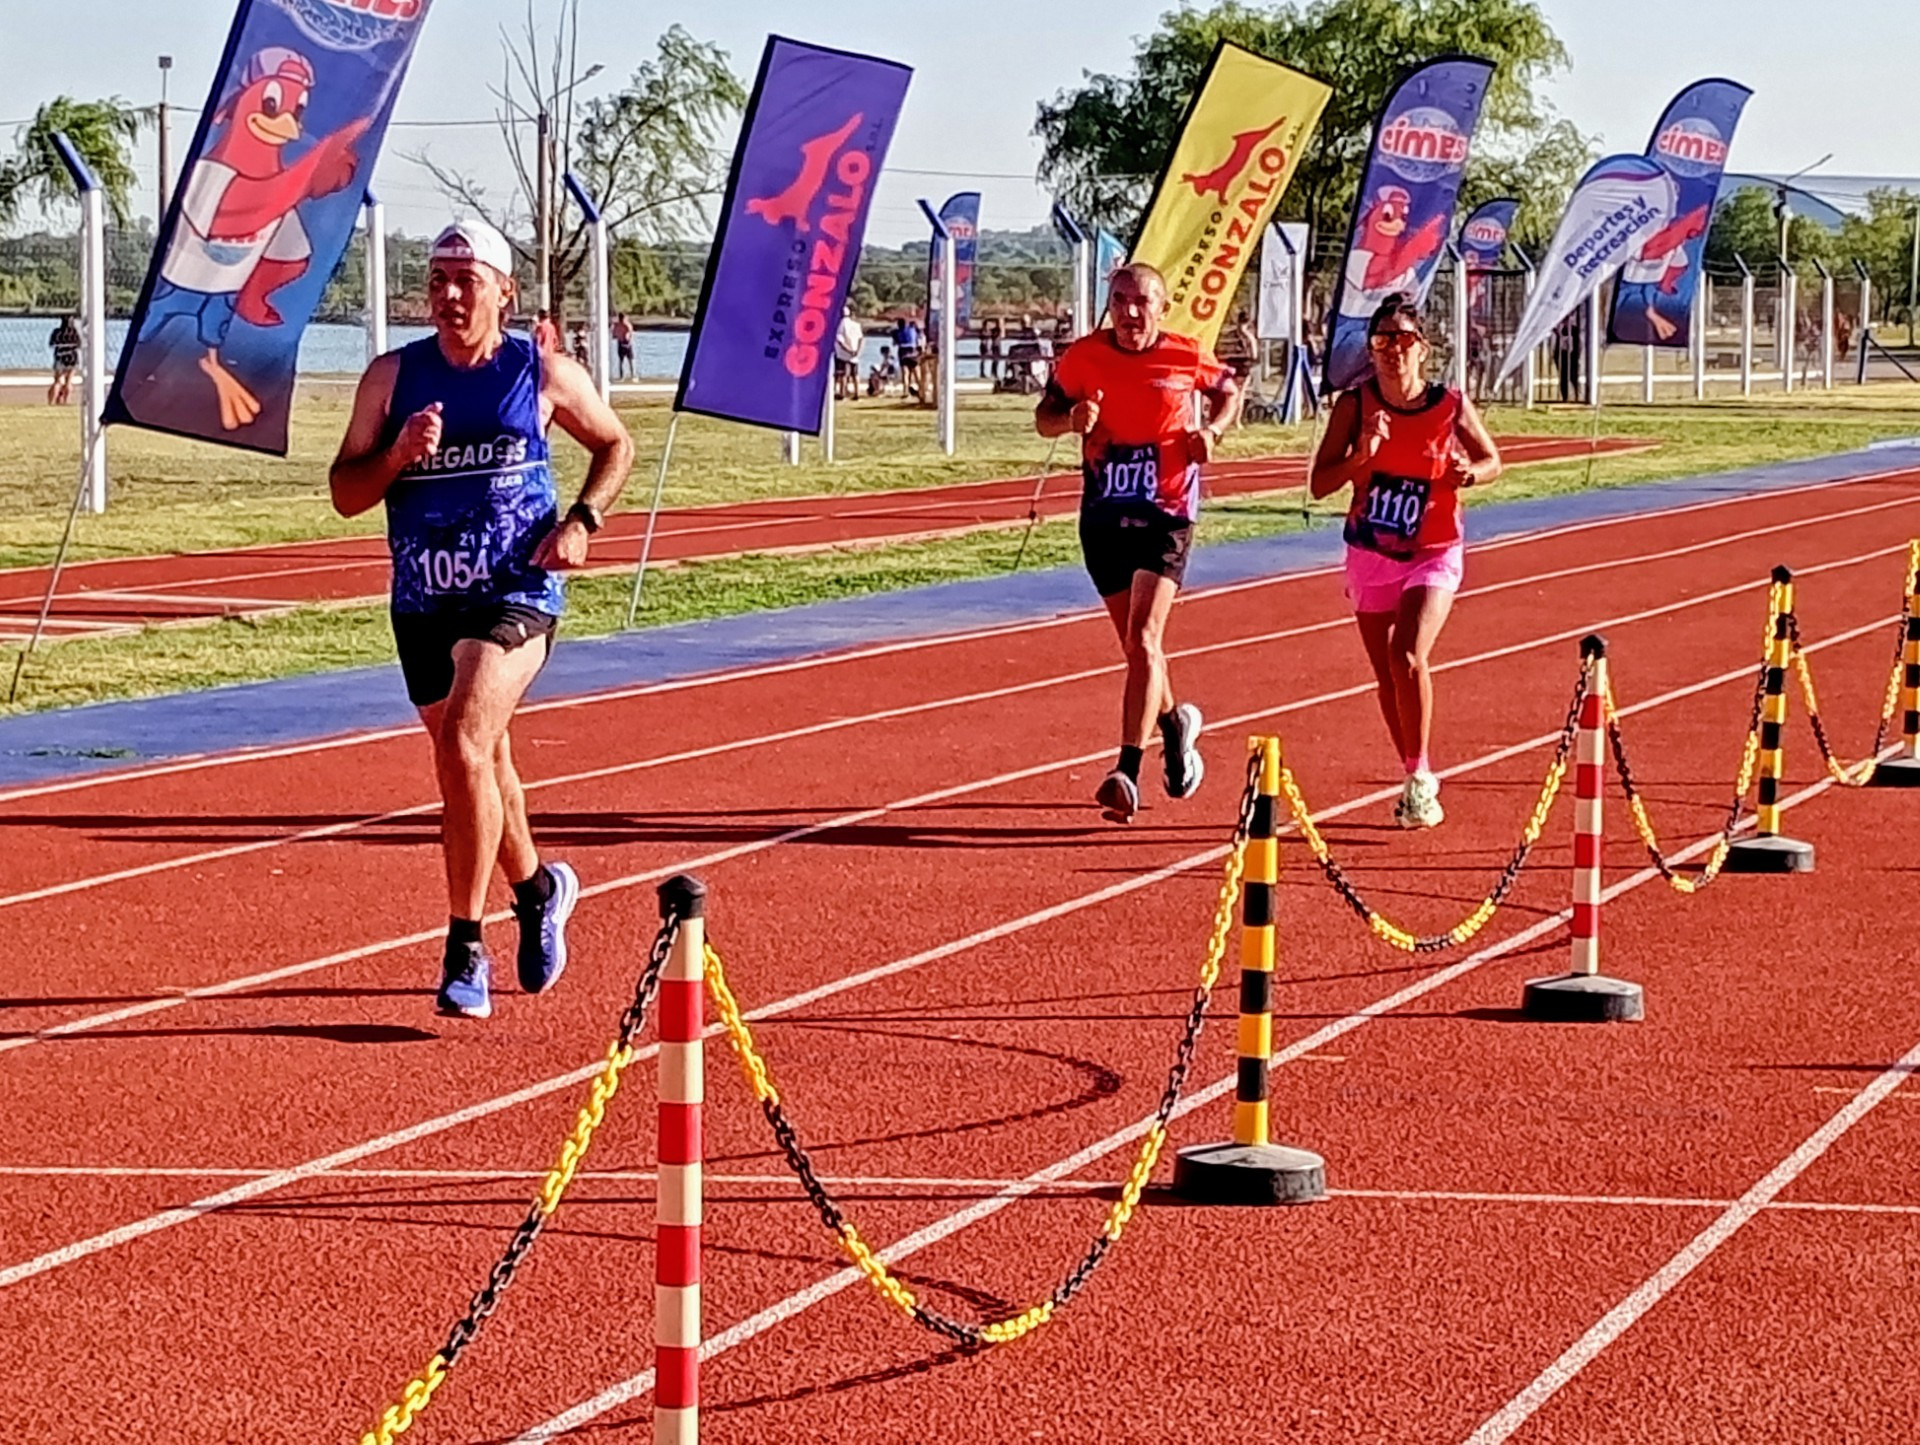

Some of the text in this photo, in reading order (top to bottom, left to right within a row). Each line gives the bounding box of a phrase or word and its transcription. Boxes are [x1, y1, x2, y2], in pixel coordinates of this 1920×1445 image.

[785, 150, 870, 377] GONZALO
[1173, 211, 1223, 306] EXPRESO
[1190, 147, 1286, 321] GONZALO
[1563, 204, 1635, 269] Deportes
[763, 240, 807, 360] EXPRESO
[1103, 460, 1159, 498] 1078
[1367, 485, 1420, 524] 1110
[418, 547, 492, 594] 1054
